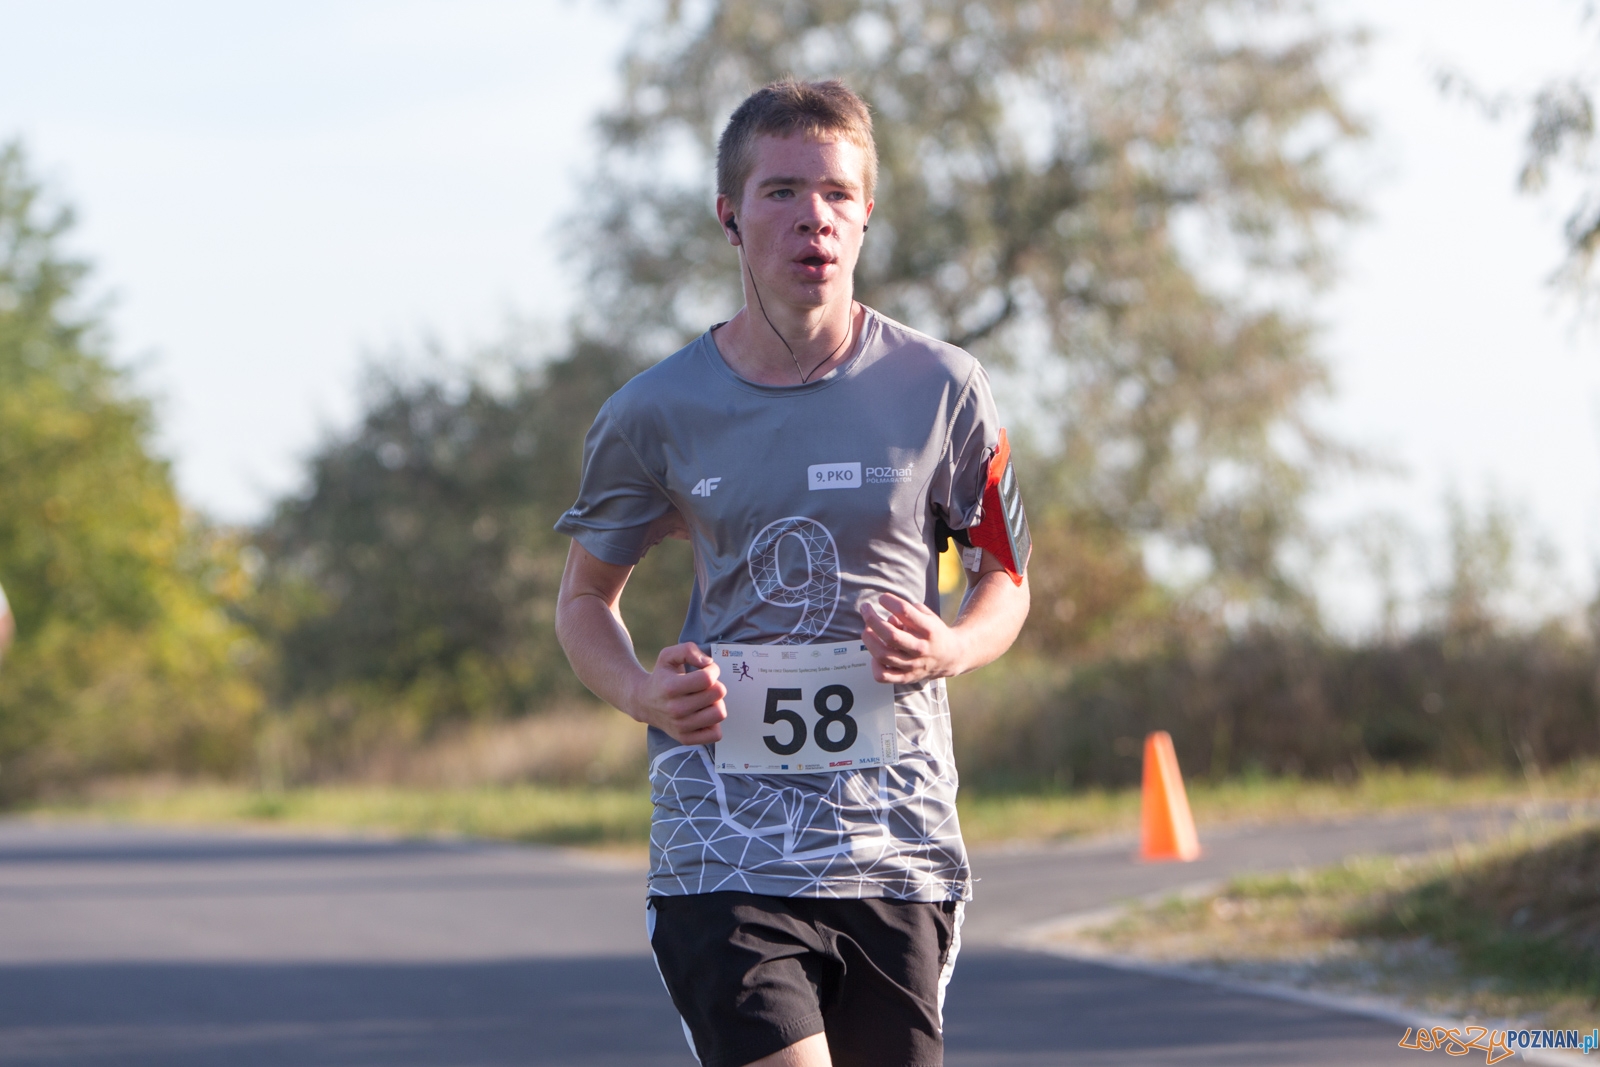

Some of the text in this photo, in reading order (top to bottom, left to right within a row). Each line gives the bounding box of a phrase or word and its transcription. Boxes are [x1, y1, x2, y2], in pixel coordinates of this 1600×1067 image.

[691, 476, 722, 498] 4F
[815, 469, 854, 483] 9. PKO
[748, 516, 841, 646] 9
[762, 684, 858, 756] 58
